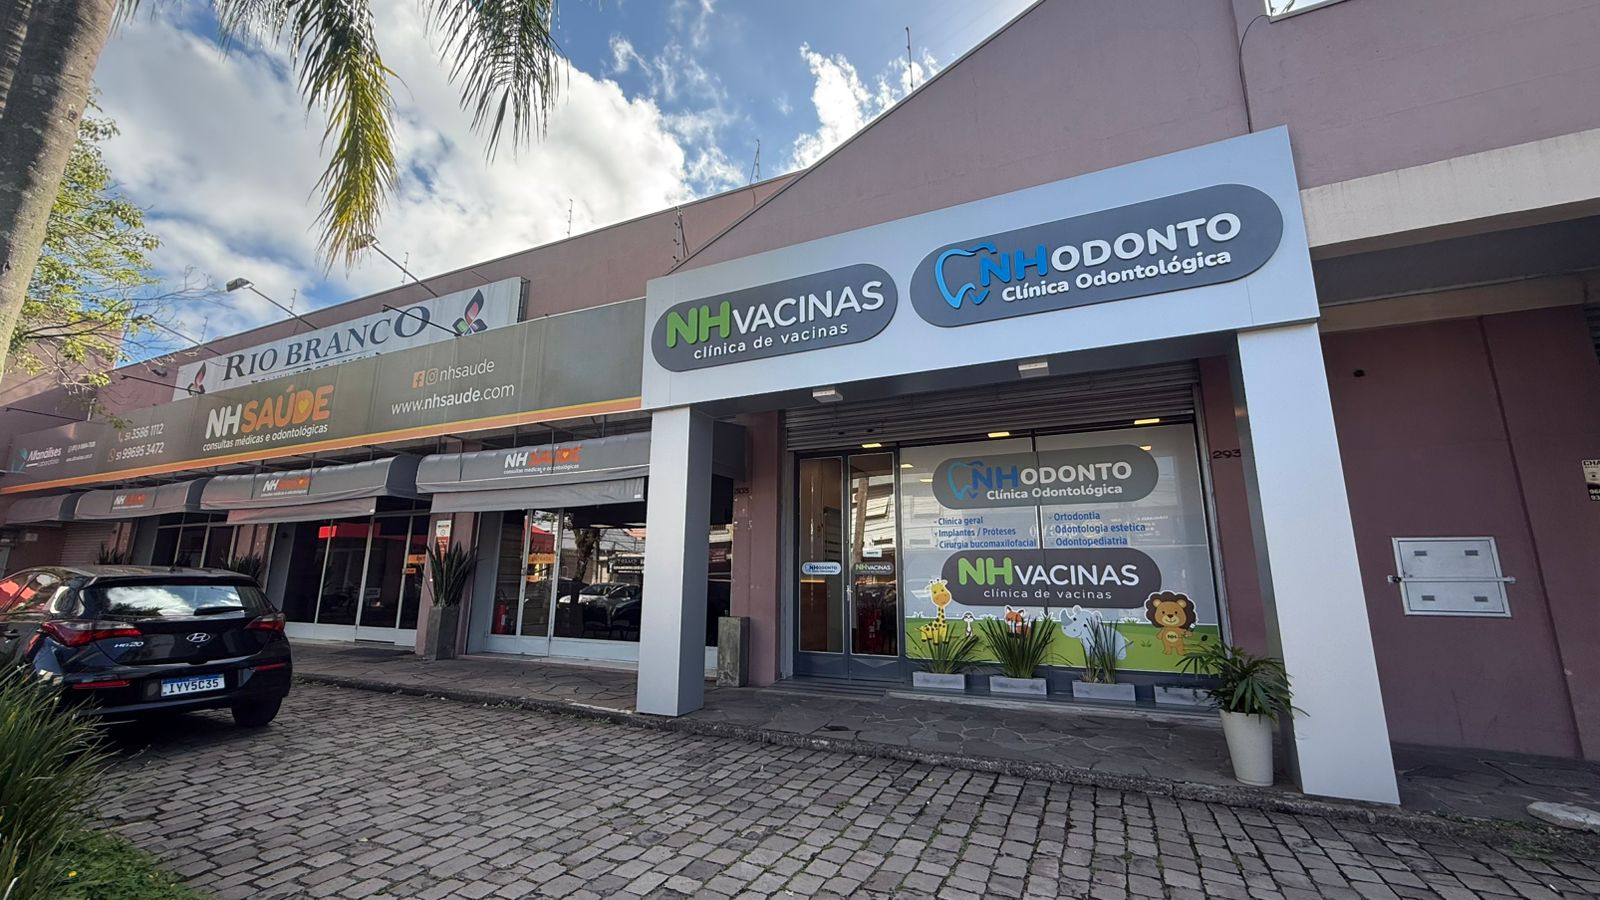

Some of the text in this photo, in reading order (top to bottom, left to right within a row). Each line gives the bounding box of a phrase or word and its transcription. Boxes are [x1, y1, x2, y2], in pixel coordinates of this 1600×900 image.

[1001, 251, 1231, 302] Clínica Odontológica
[222, 348, 278, 381] RIO
[285, 305, 431, 367] BRANCO
[693, 322, 848, 360] clínica de vacinas
[439, 358, 495, 382] nhsaude
[391, 384, 515, 415] www.nhsaude.com
[202, 424, 328, 452] consultas médicas e odontológicas
[145, 442, 165, 455] 3472
[1212, 449, 1241, 459] 293
[986, 486, 1123, 501] Clínica Odontológica
[963, 516, 984, 526] geral
[982, 528, 1016, 536] Próteses
[970, 539, 1037, 549] bucomaxilofacial
[983, 588, 1112, 600] clínica de vacinas
[169, 678, 219, 694] IYY5C35
